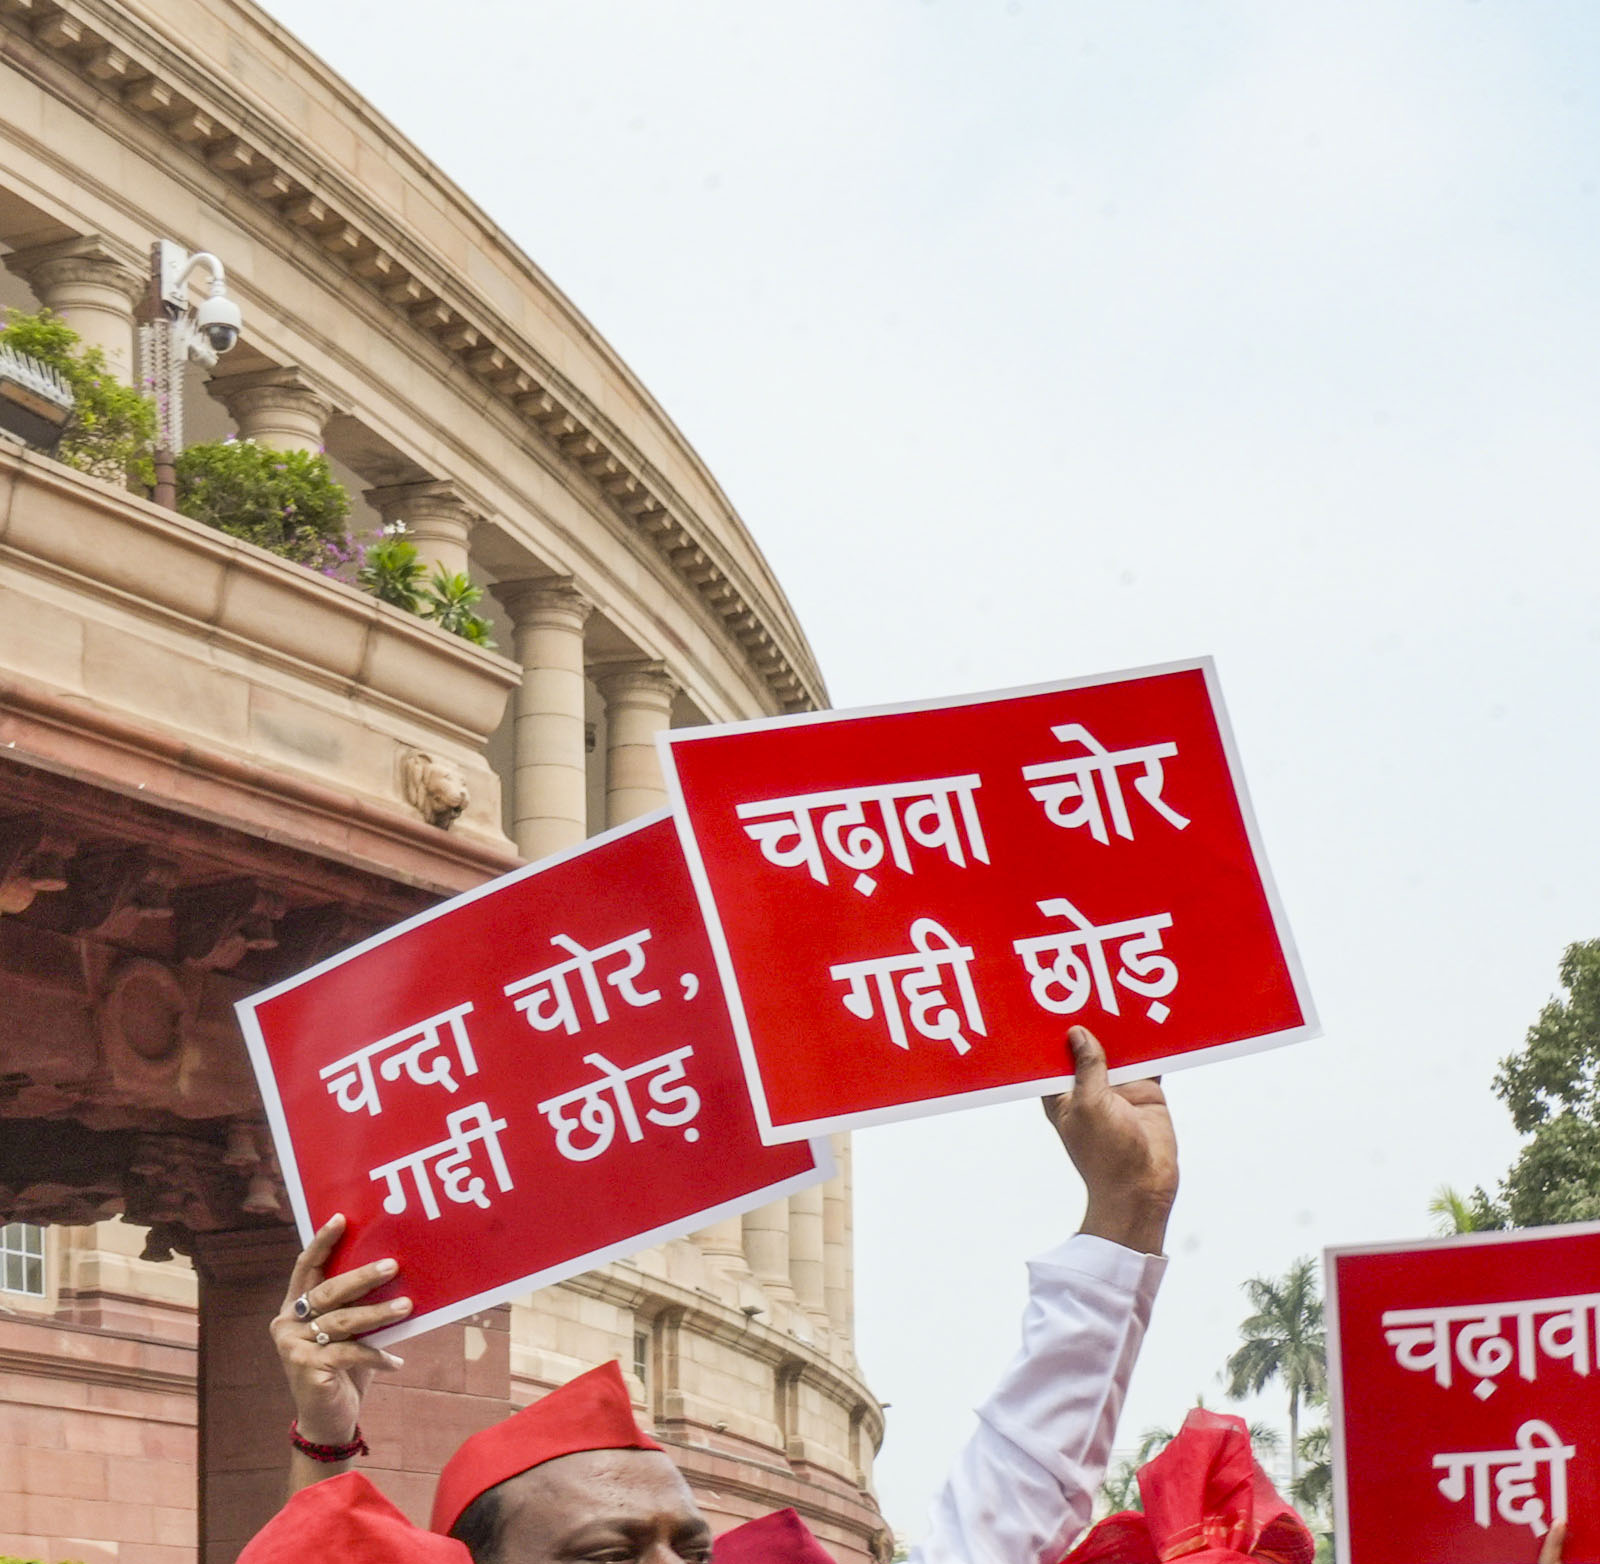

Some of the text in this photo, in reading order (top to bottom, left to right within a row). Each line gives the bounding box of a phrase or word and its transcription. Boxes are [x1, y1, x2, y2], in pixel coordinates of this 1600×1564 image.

[736, 724, 1190, 896] चढ़ावा चोर
[830, 898, 1178, 1055] गद्दी छोड़
[319, 1001, 478, 1116] चन्दा
[369, 1046, 700, 1221] गद्दी छोड़
[1433, 1420, 1575, 1539] गद्दी
